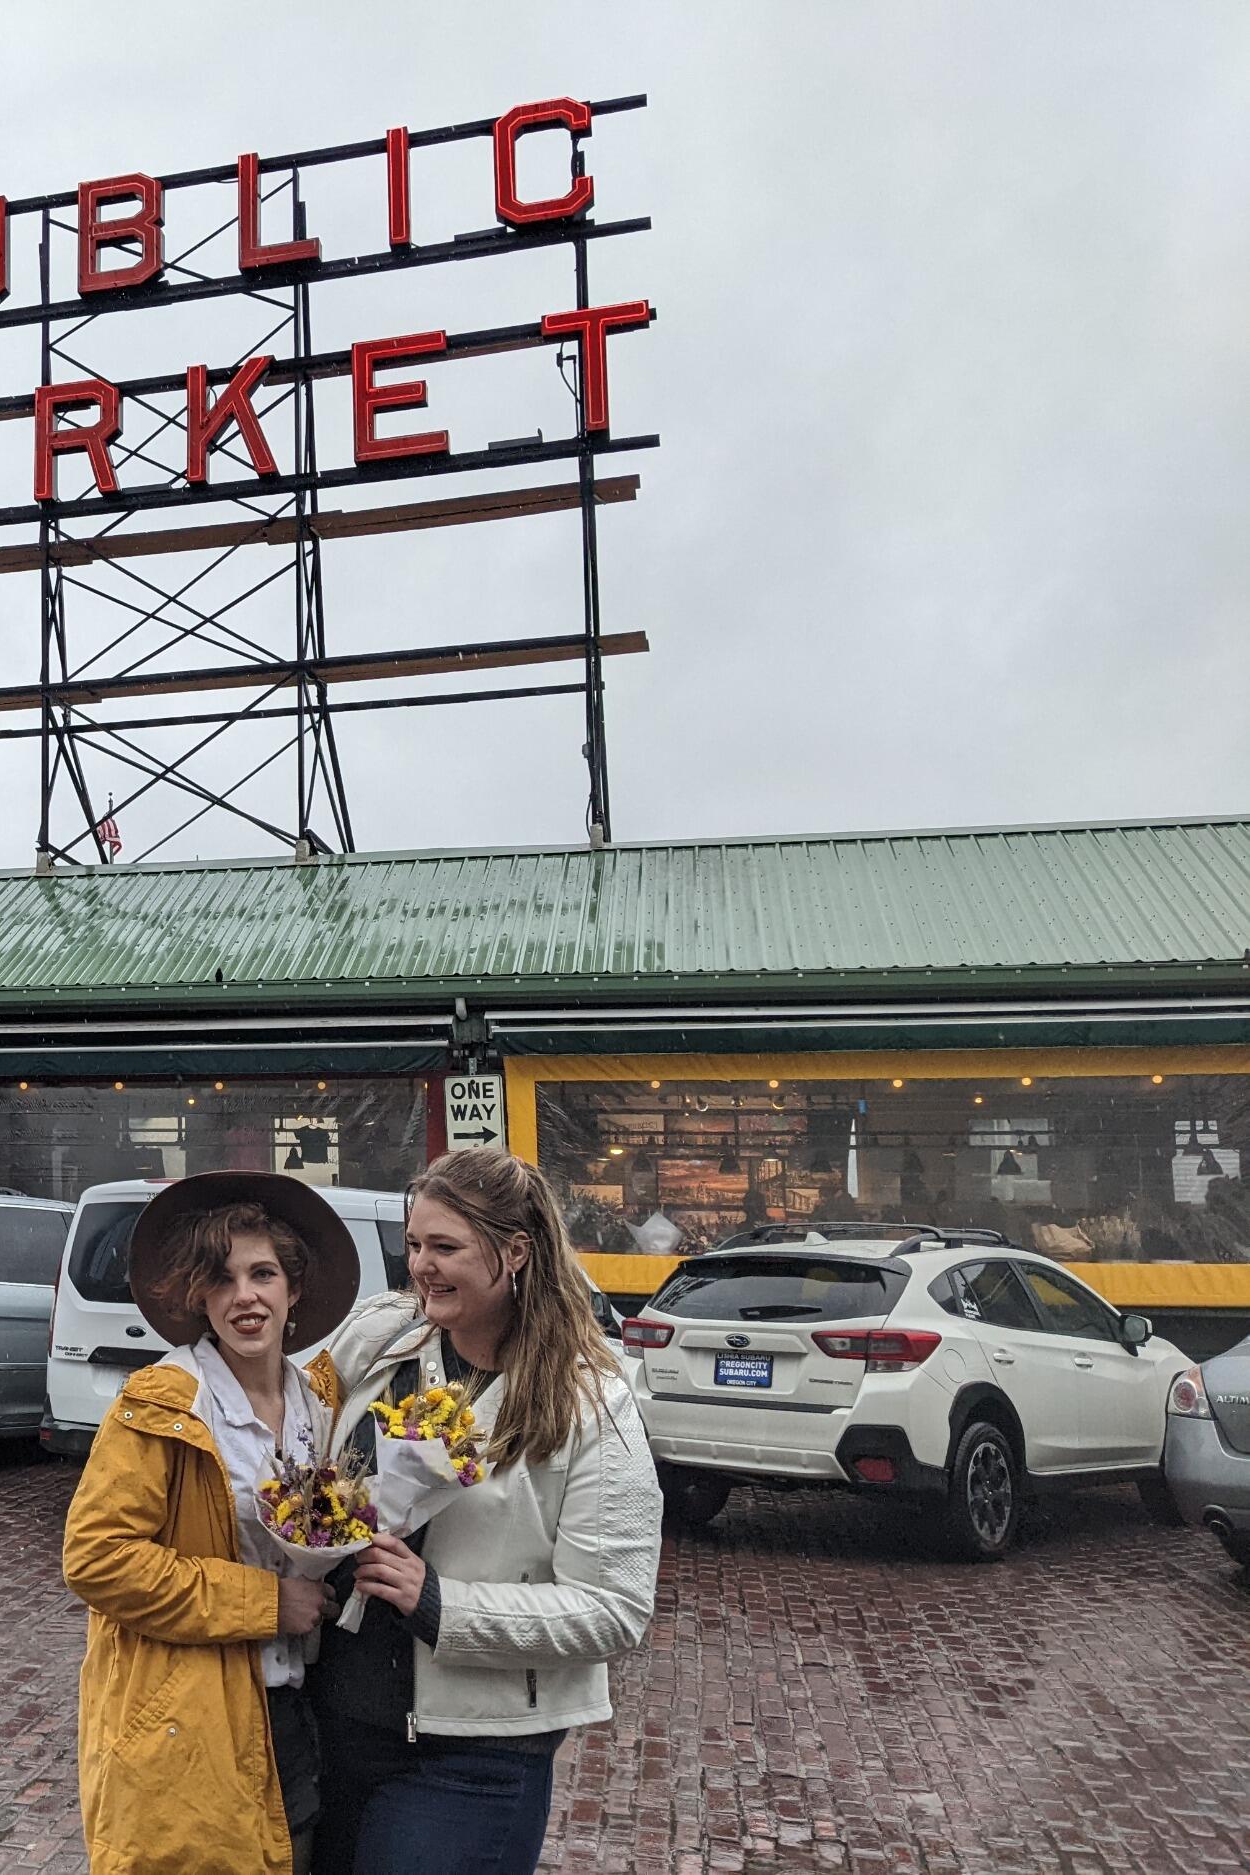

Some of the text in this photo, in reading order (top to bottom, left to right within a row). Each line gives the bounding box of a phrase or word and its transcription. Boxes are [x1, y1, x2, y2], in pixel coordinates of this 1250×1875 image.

[450, 1081, 495, 1100] ONE
[450, 1103, 496, 1121] WAY
[719, 1368, 768, 1378] SUBARU.COM
